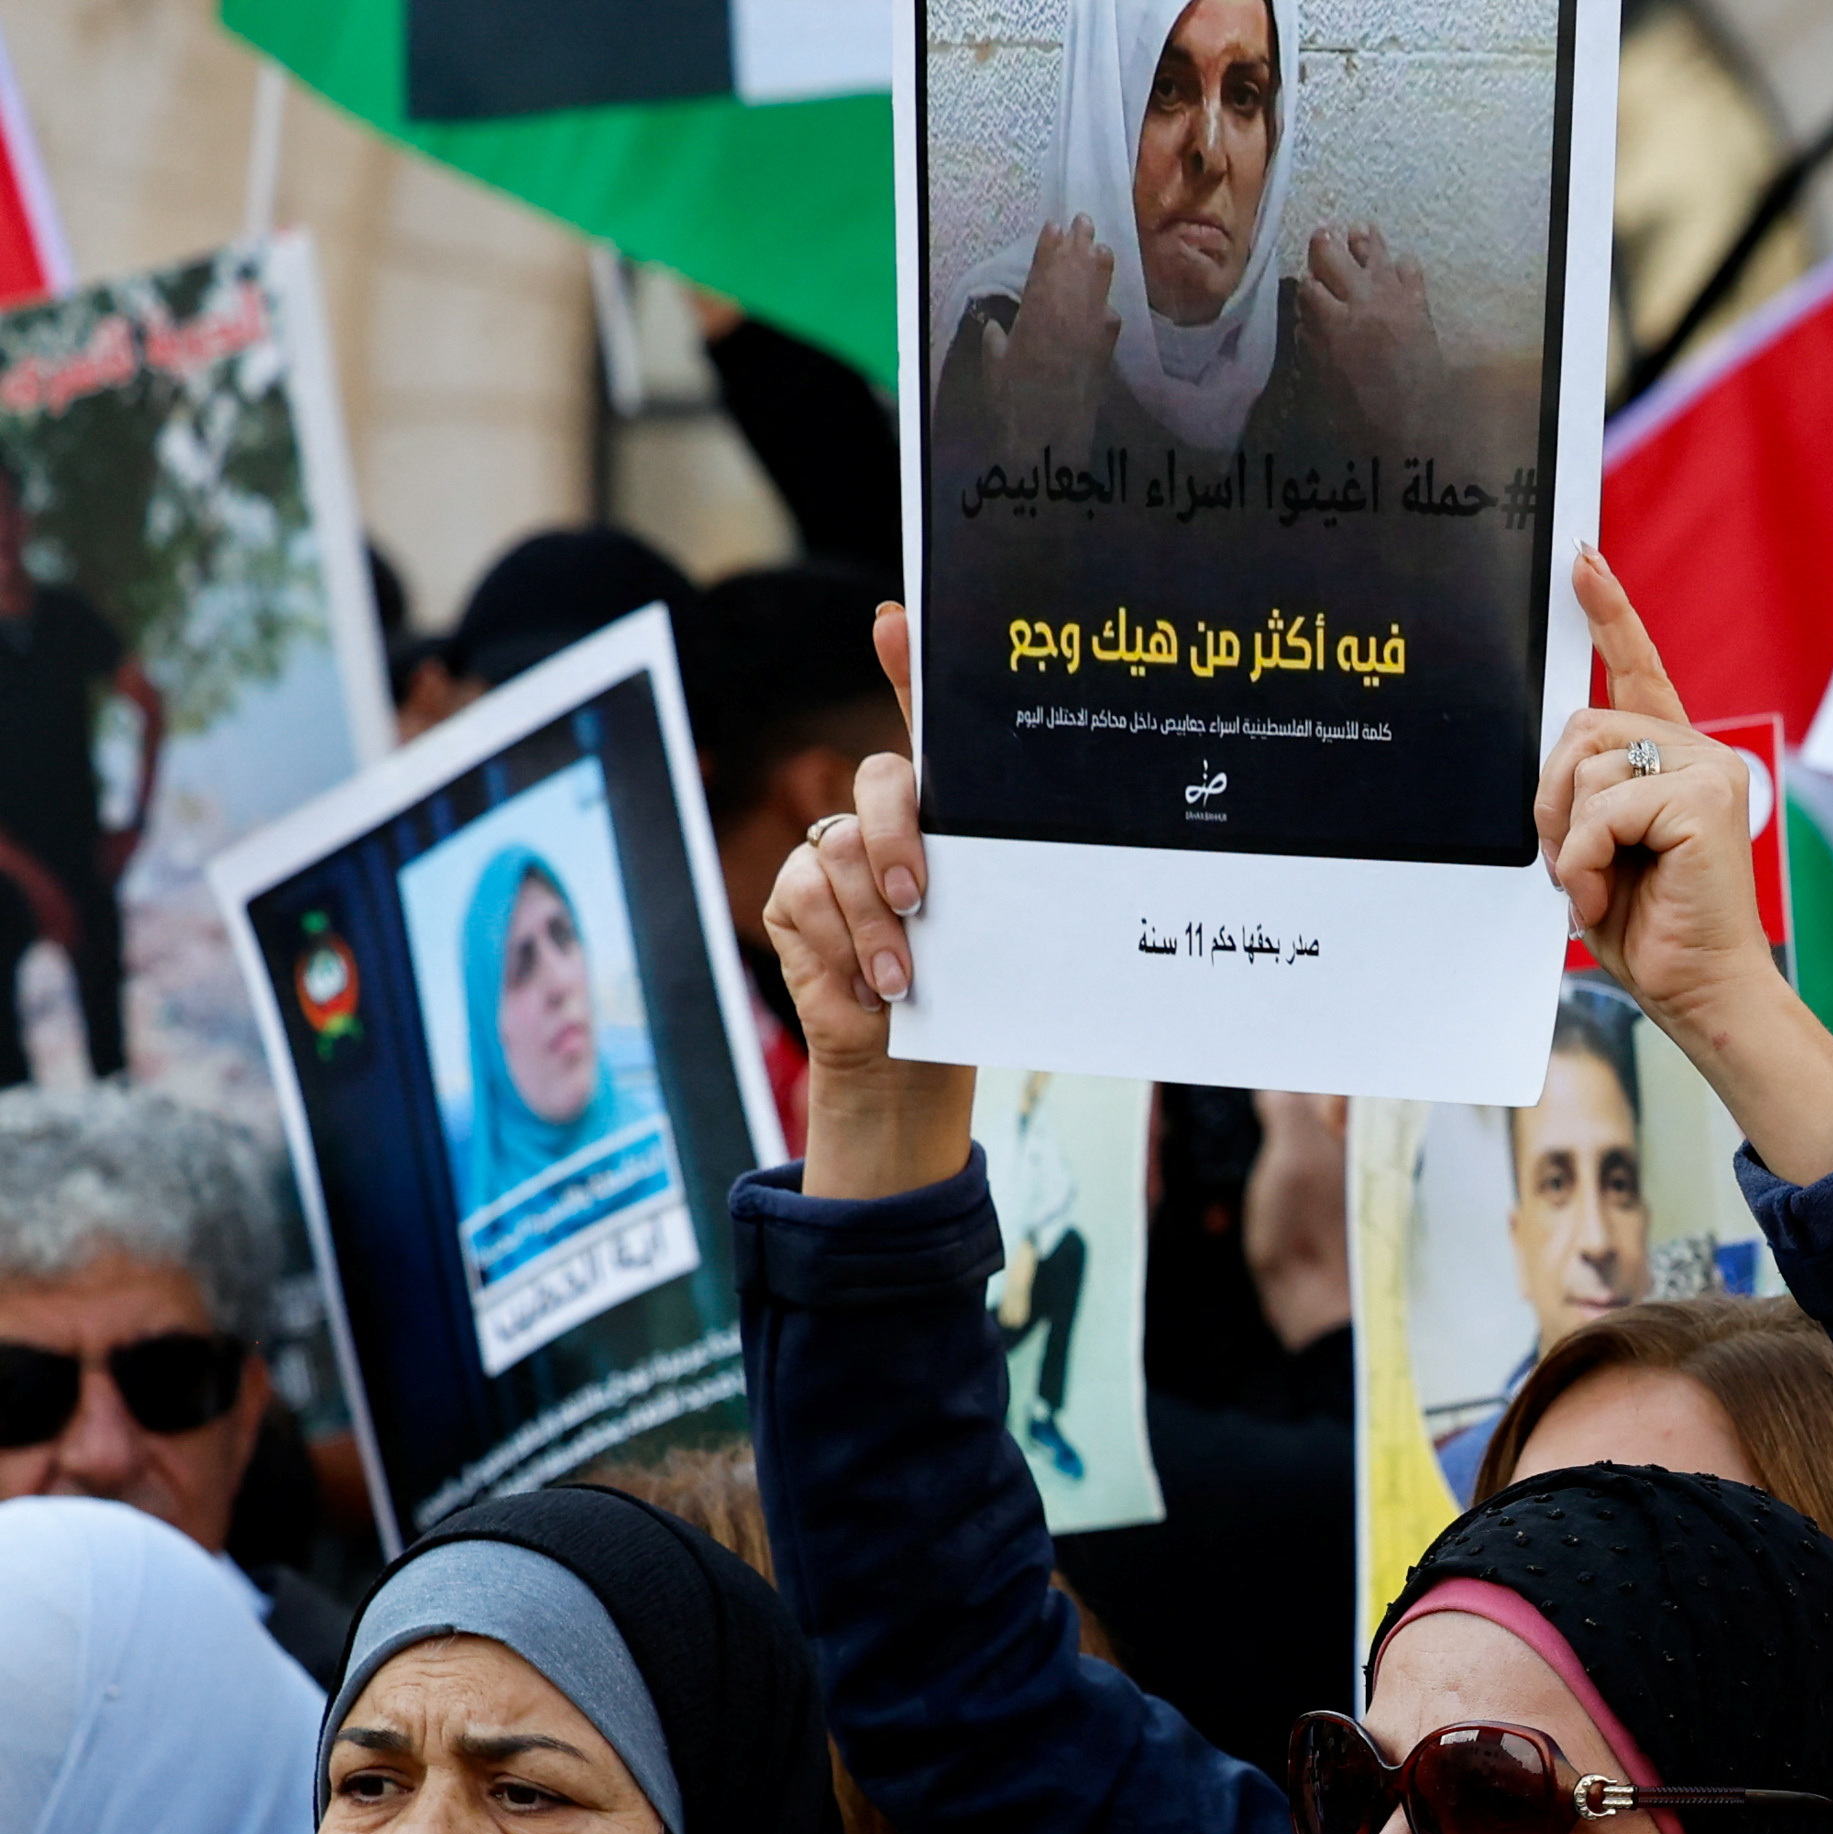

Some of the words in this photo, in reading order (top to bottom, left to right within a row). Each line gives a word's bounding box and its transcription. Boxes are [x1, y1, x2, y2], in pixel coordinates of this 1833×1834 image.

[1010, 617, 1081, 673] وجع
[1091, 607, 1178, 676] هيك
[1190, 621, 1240, 677] من
[1250, 609, 1325, 682] أكثر
[1337, 622, 1406, 686] فيه
[1090, 709, 1127, 731] محاكم
[1129, 712, 1158, 733] داخل
[1242, 717, 1312, 740] الفلسطينية
[1362, 723, 1392, 741] كلمة
[1138, 918, 1178, 956] سنة
[1186, 921, 1203, 957] 11
[1211, 926, 1238, 966] حكم
[1242, 925, 1281, 964] بحقها
[1286, 933, 1320, 964] صدر
